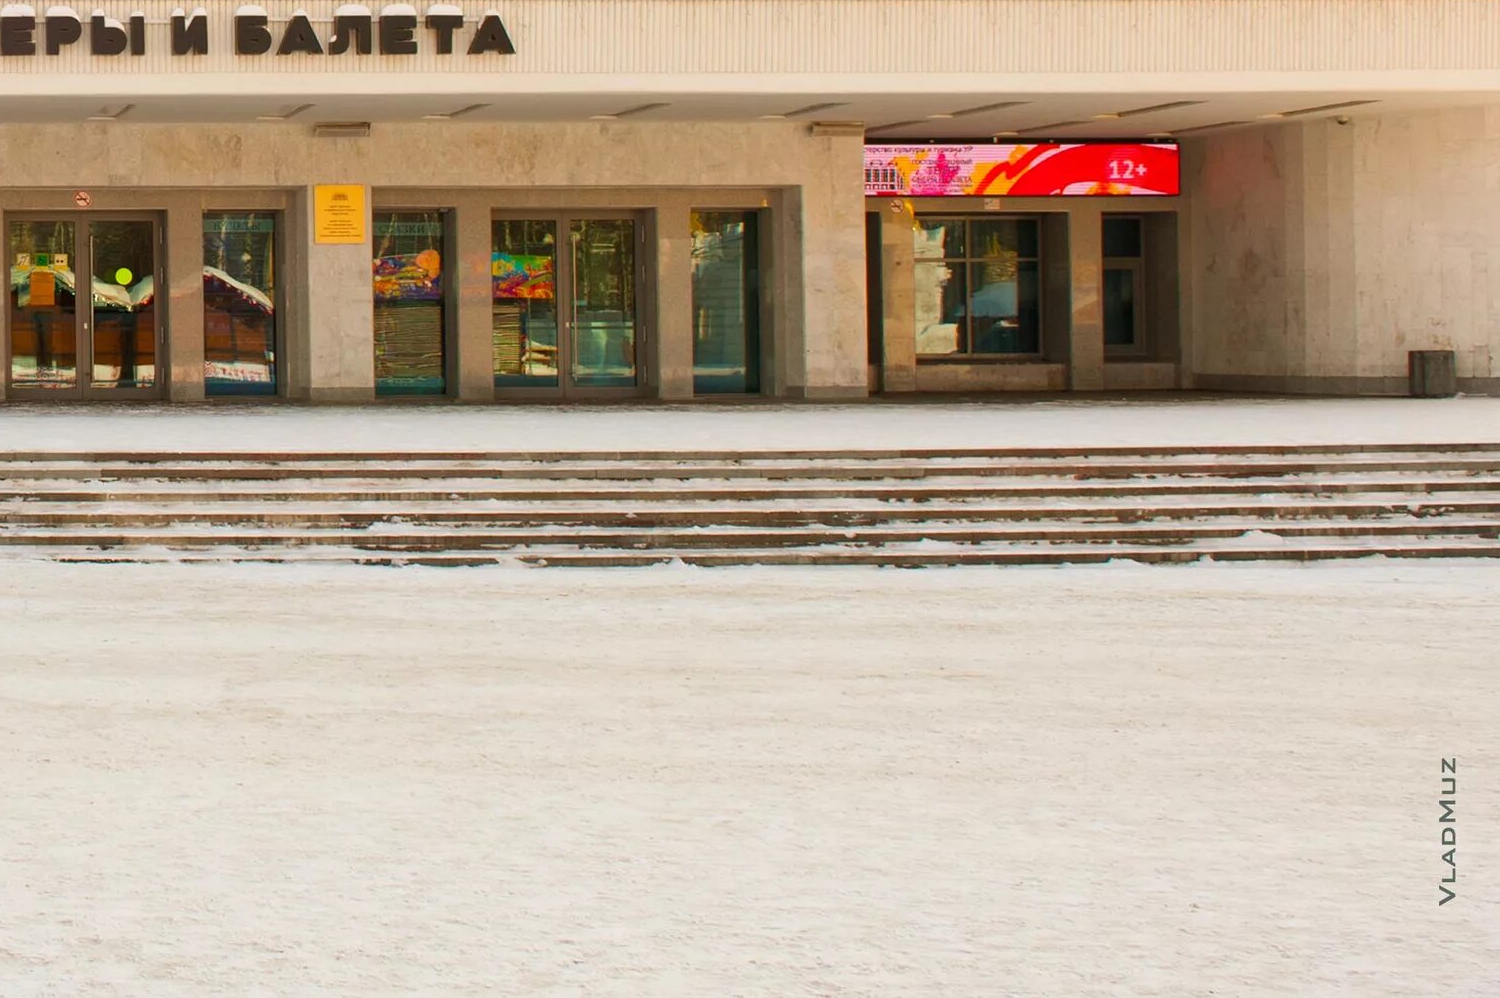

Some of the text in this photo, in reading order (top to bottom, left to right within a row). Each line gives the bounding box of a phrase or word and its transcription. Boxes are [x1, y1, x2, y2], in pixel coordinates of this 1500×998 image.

[171, 14, 209, 56] И
[234, 14, 517, 57] БАЛЕТА
[1109, 160, 1148, 179] 12+
